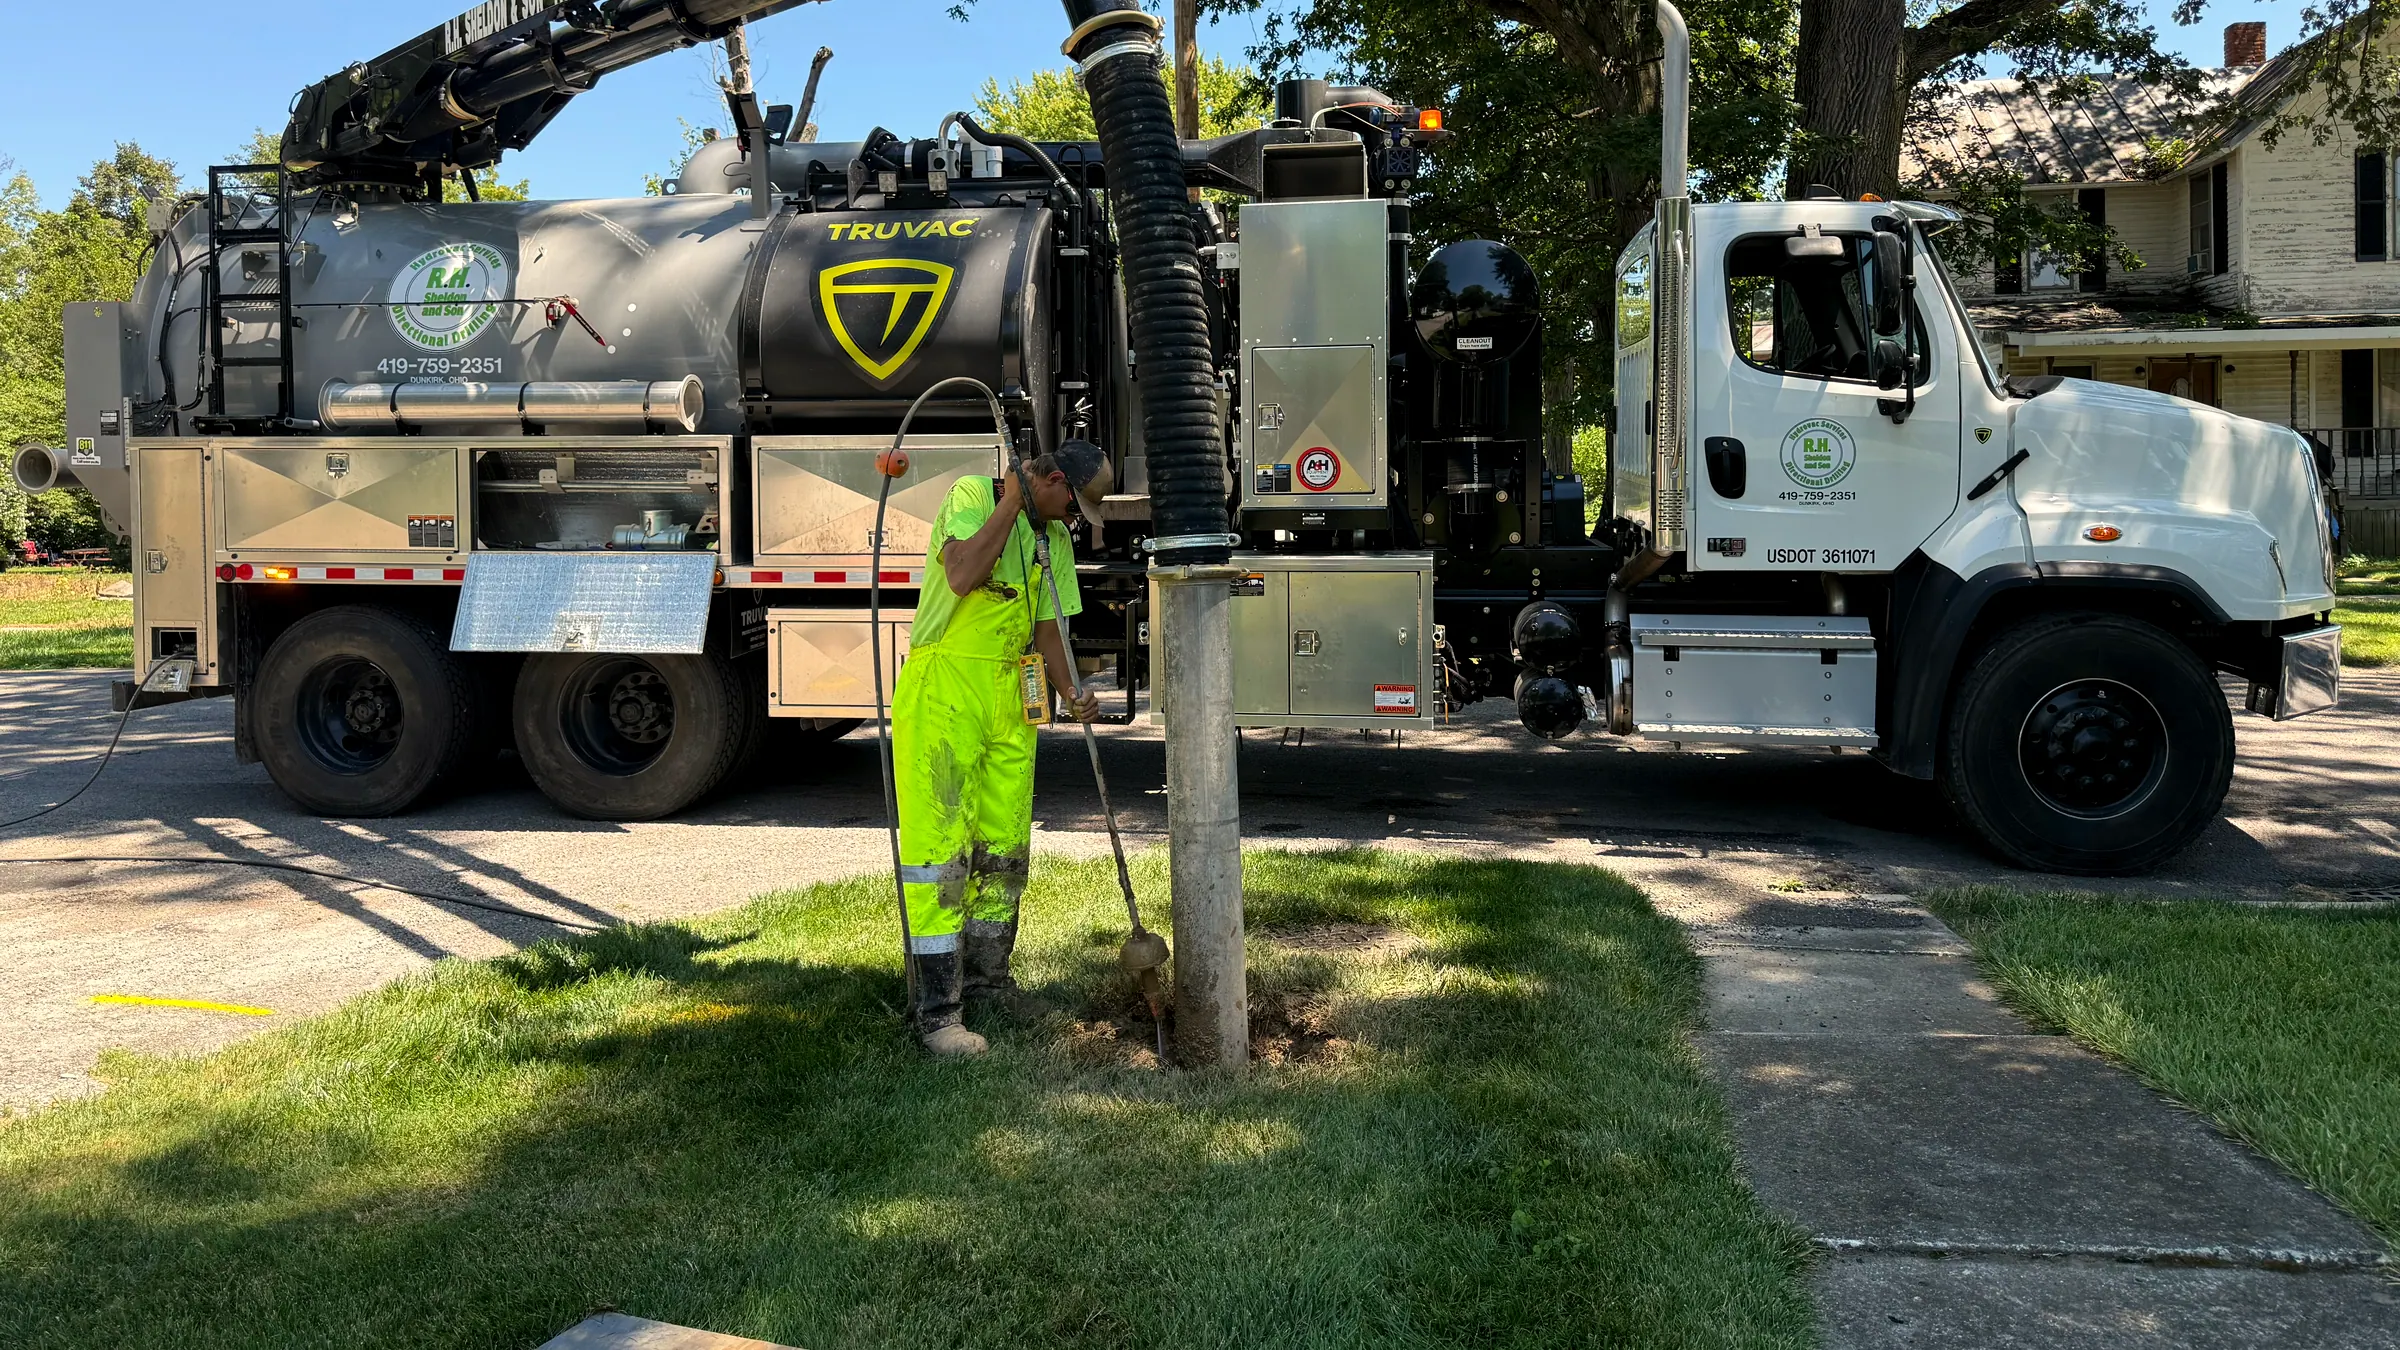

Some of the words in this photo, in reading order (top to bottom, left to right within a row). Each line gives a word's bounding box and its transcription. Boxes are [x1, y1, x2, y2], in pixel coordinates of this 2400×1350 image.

[445, 16, 462, 55] R.H.
[465, 0, 507, 45] SHELDON
[828, 218, 979, 241] TRUVAC
[410, 244, 464, 271] Hydrovac
[469, 244, 501, 269] Services
[426, 267, 470, 288] R.H.
[424, 292, 467, 303] Sheldon
[422, 305, 442, 316] and
[444, 305, 464, 316] Son
[392, 304, 449, 346] Directional
[451, 303, 497, 344] Drilling
[377, 358, 502, 374] 419-759-2351
[449, 376, 468, 384] OHIO
[1789, 421, 1820, 441] Hydrovac
[1821, 421, 1847, 440] Services
[80, 440, 91, 449] 811
[1803, 438, 1831, 452] R.H.
[1307, 460, 1329, 471] A&H
[1785, 461, 1823, 486] Directional
[1824, 461, 1851, 485] Drilling
[1779, 491, 1856, 500] 419-759-2351
[1709, 539, 1731, 550] 114
[1767, 549, 1816, 563] USDOT
[1822, 549, 1875, 563] 3611071
